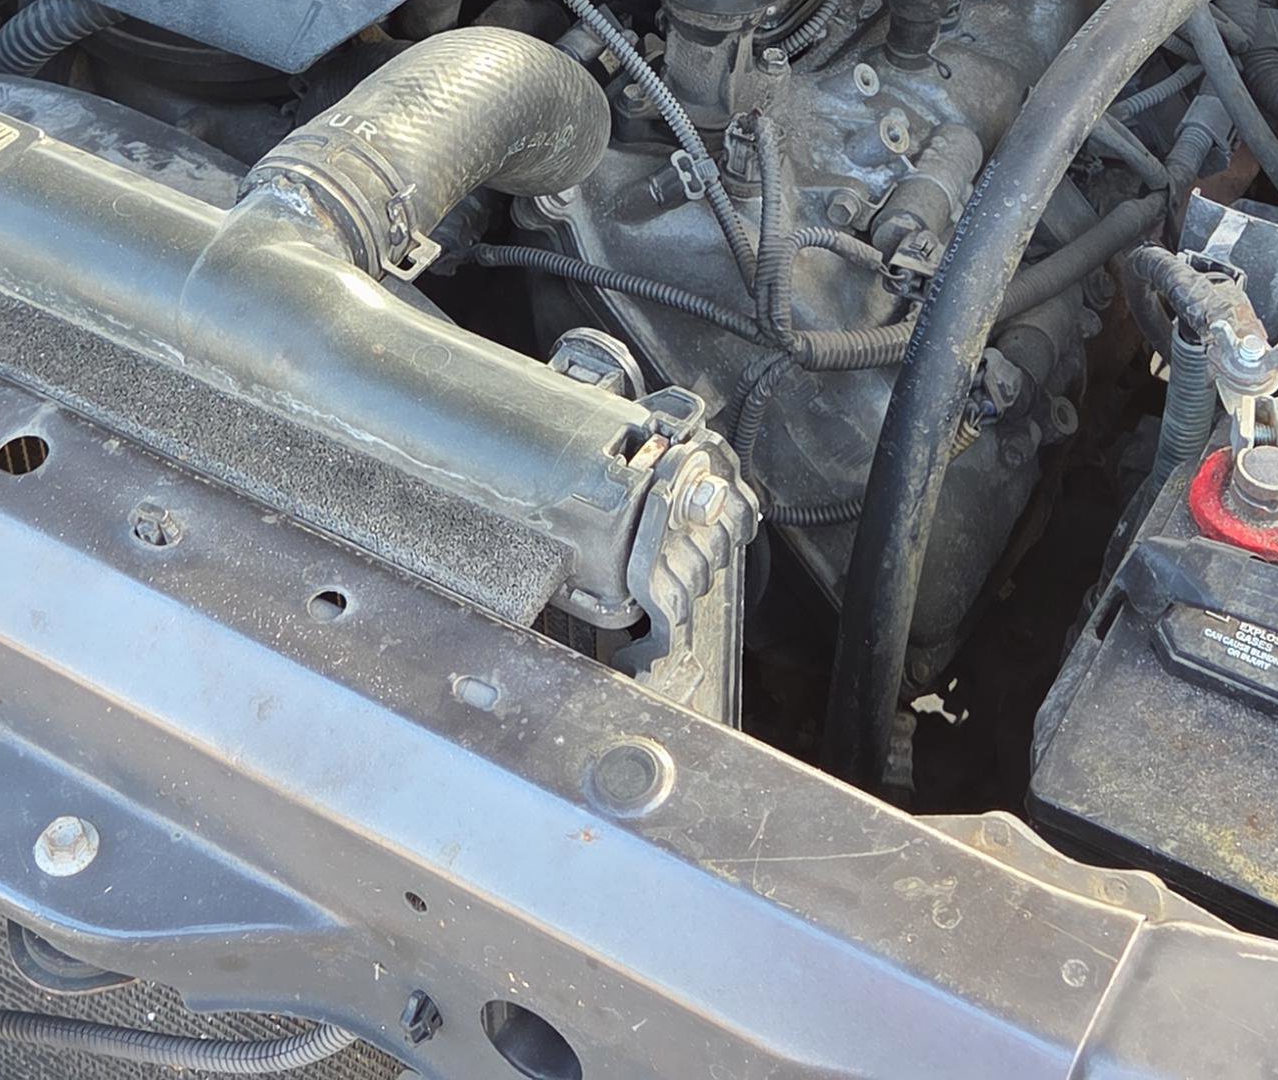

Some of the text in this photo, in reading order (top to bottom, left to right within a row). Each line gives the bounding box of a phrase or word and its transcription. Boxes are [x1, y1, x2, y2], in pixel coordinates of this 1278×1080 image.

[1204, 628, 1223, 642] CAN
[1222, 636, 1251, 653] CAUSE
[1235, 631, 1274, 653] GASES
[1226, 648, 1272, 670] OR INJURY
